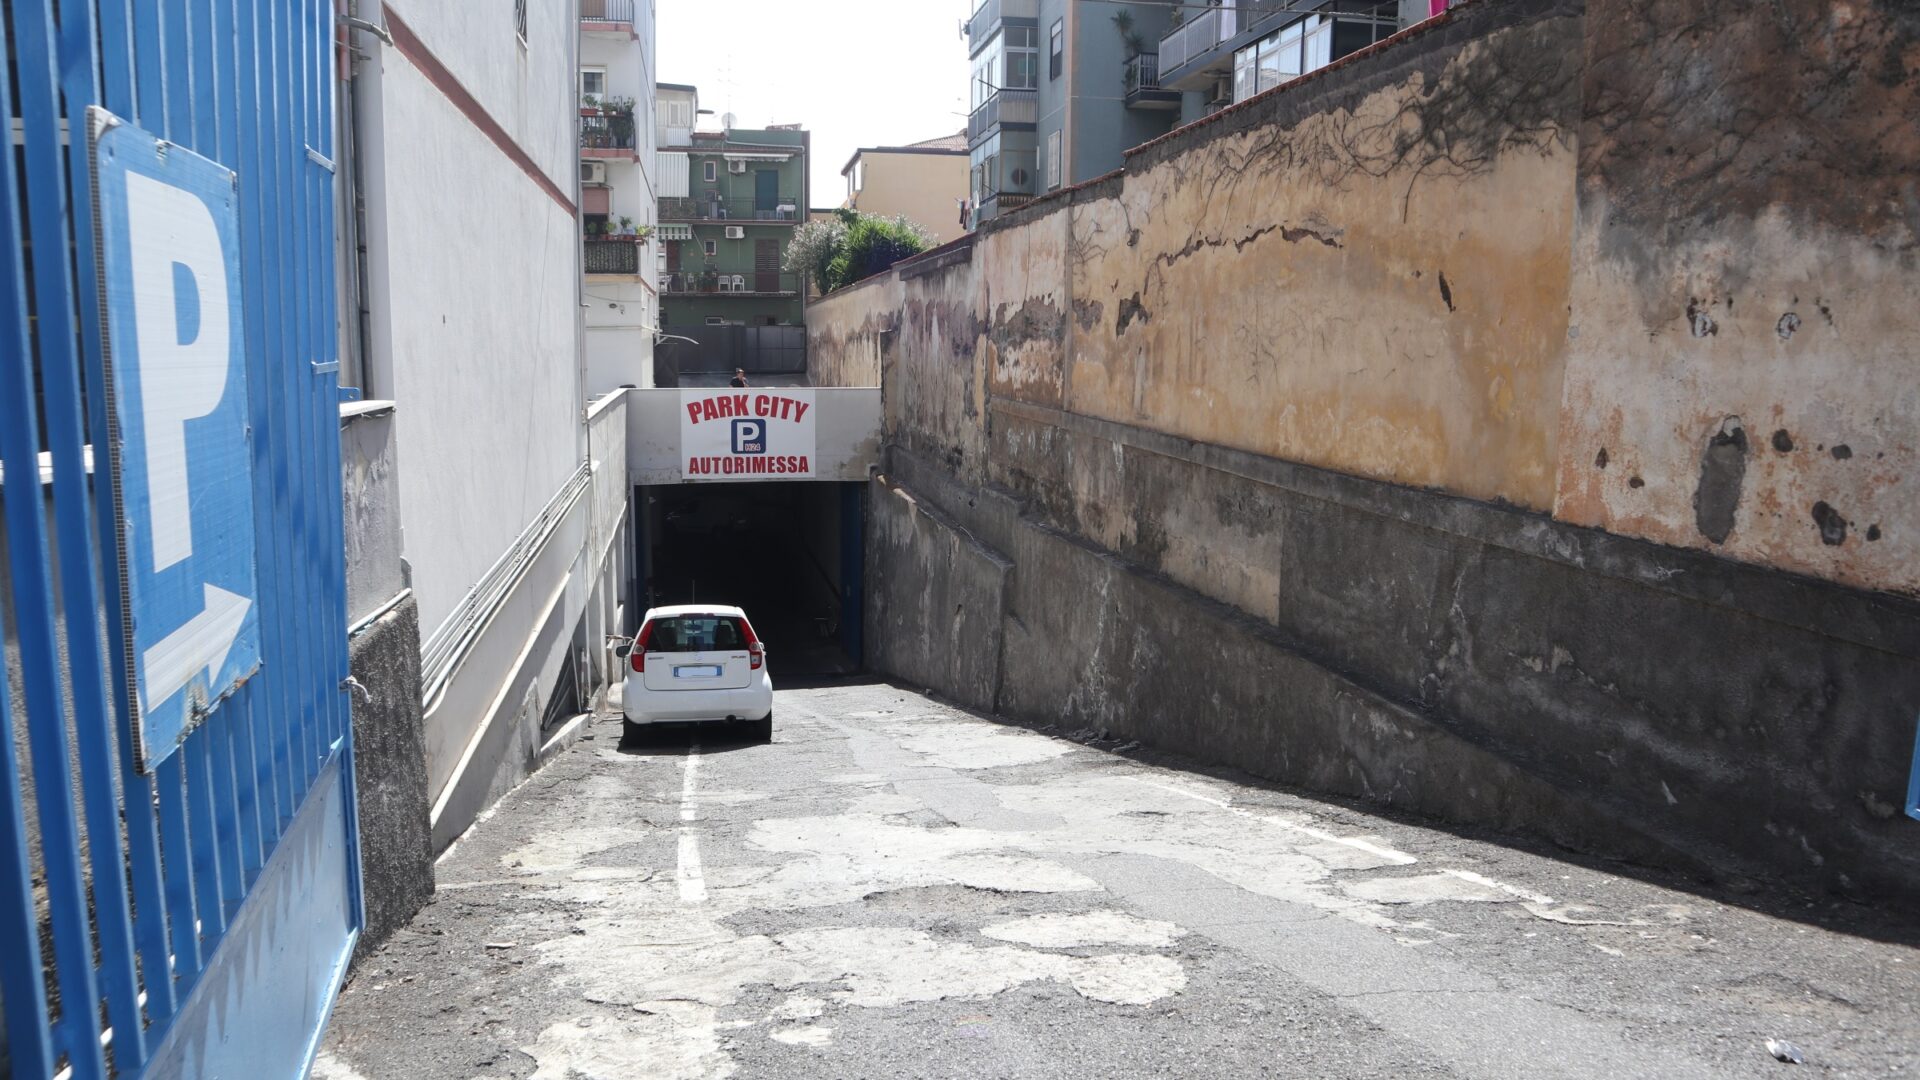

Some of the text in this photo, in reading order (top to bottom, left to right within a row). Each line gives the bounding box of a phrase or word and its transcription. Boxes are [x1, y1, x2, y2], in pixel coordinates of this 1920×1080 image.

[125, 170, 230, 573] P
[687, 395, 809, 424] PARK CITY
[736, 422, 760, 451] P
[688, 456, 809, 475] AUTORIMESSA
